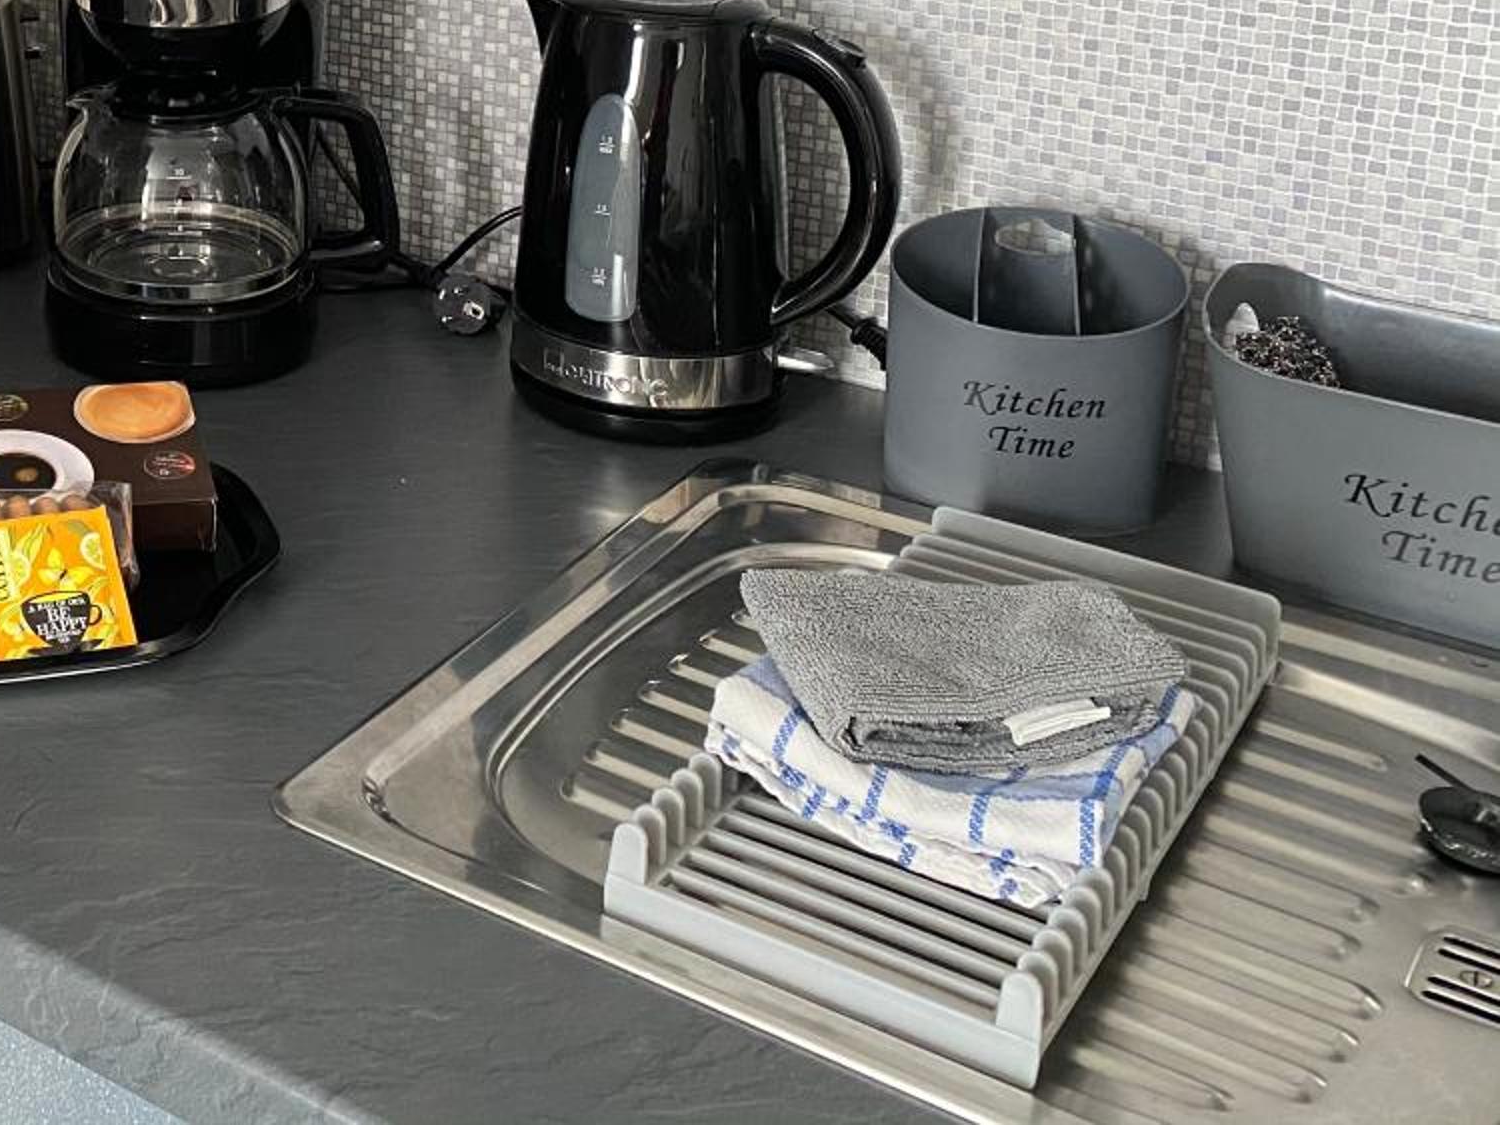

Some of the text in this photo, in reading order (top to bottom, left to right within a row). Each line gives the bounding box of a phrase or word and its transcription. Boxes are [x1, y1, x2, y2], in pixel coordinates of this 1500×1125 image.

[963, 379, 1106, 419] Kitchen
[988, 426, 1075, 459] Time
[1381, 529, 1500, 584] Time
[36, 617, 88, 636] HAPPY
[47, 607, 71, 622] BE
